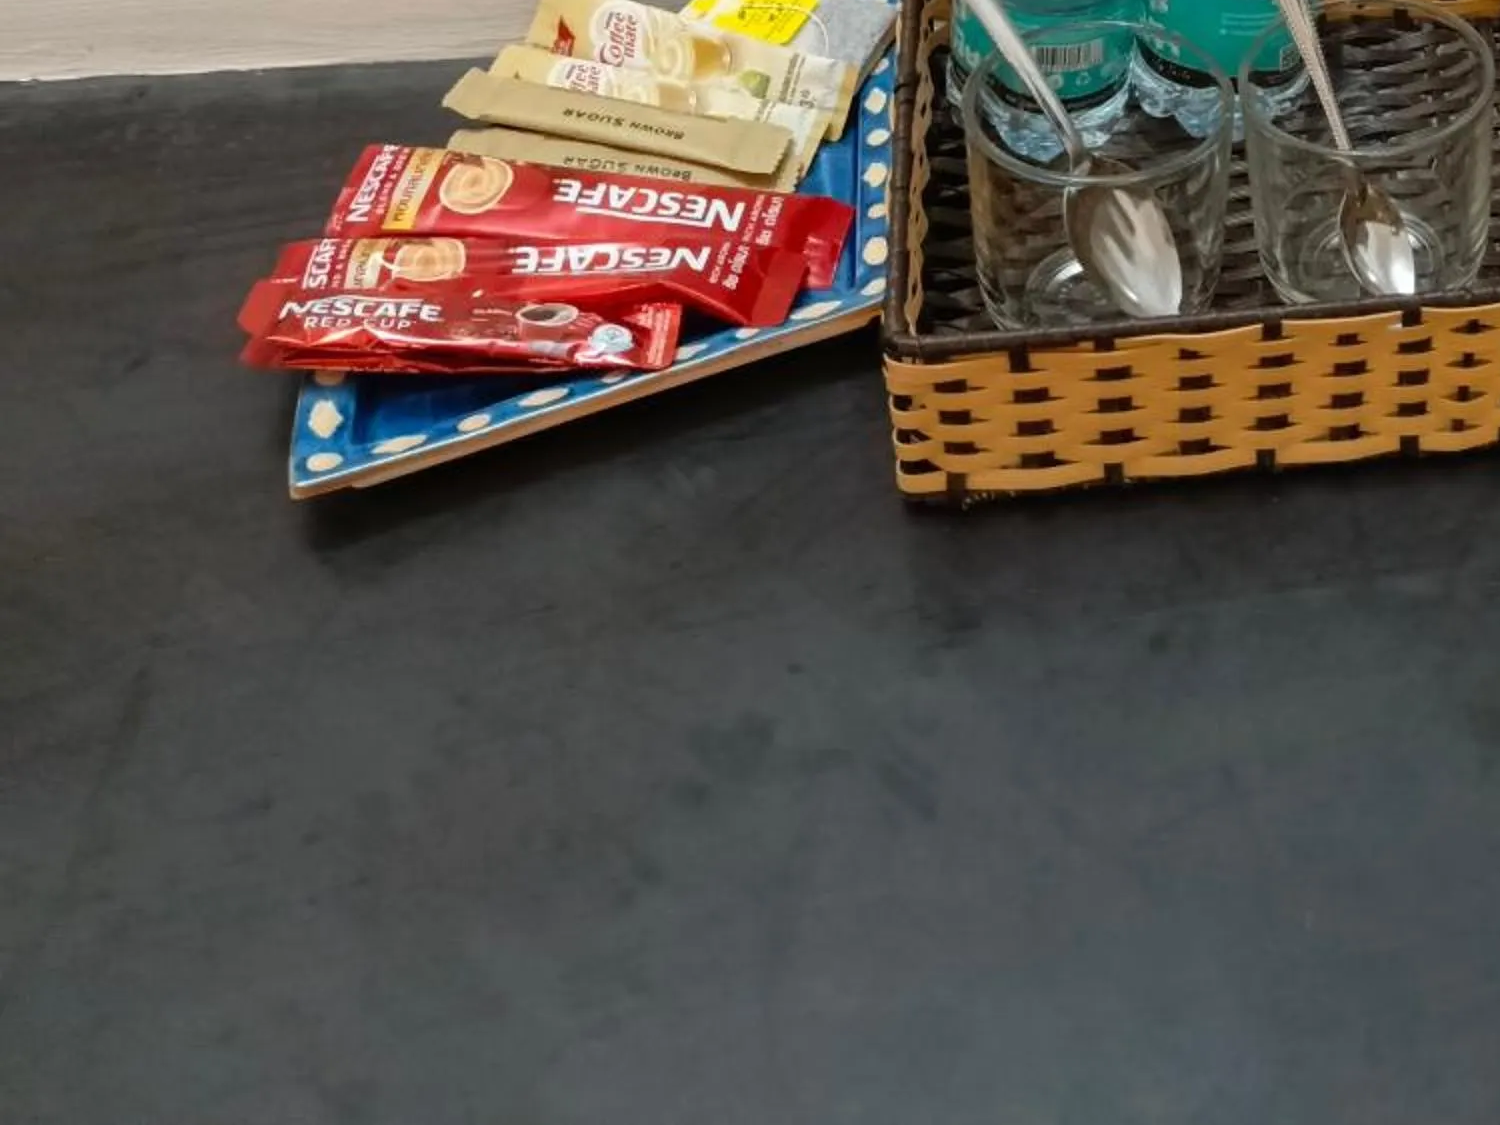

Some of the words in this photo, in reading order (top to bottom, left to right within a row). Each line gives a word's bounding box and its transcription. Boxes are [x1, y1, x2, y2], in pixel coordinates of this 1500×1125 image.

[600, 11, 626, 67] Coffee
[623, 15, 639, 58] mate
[563, 108, 625, 126] SUGAR
[629, 121, 686, 140] BROWN
[563, 156, 628, 172] SUGAR
[634, 163, 693, 180] BROWN
